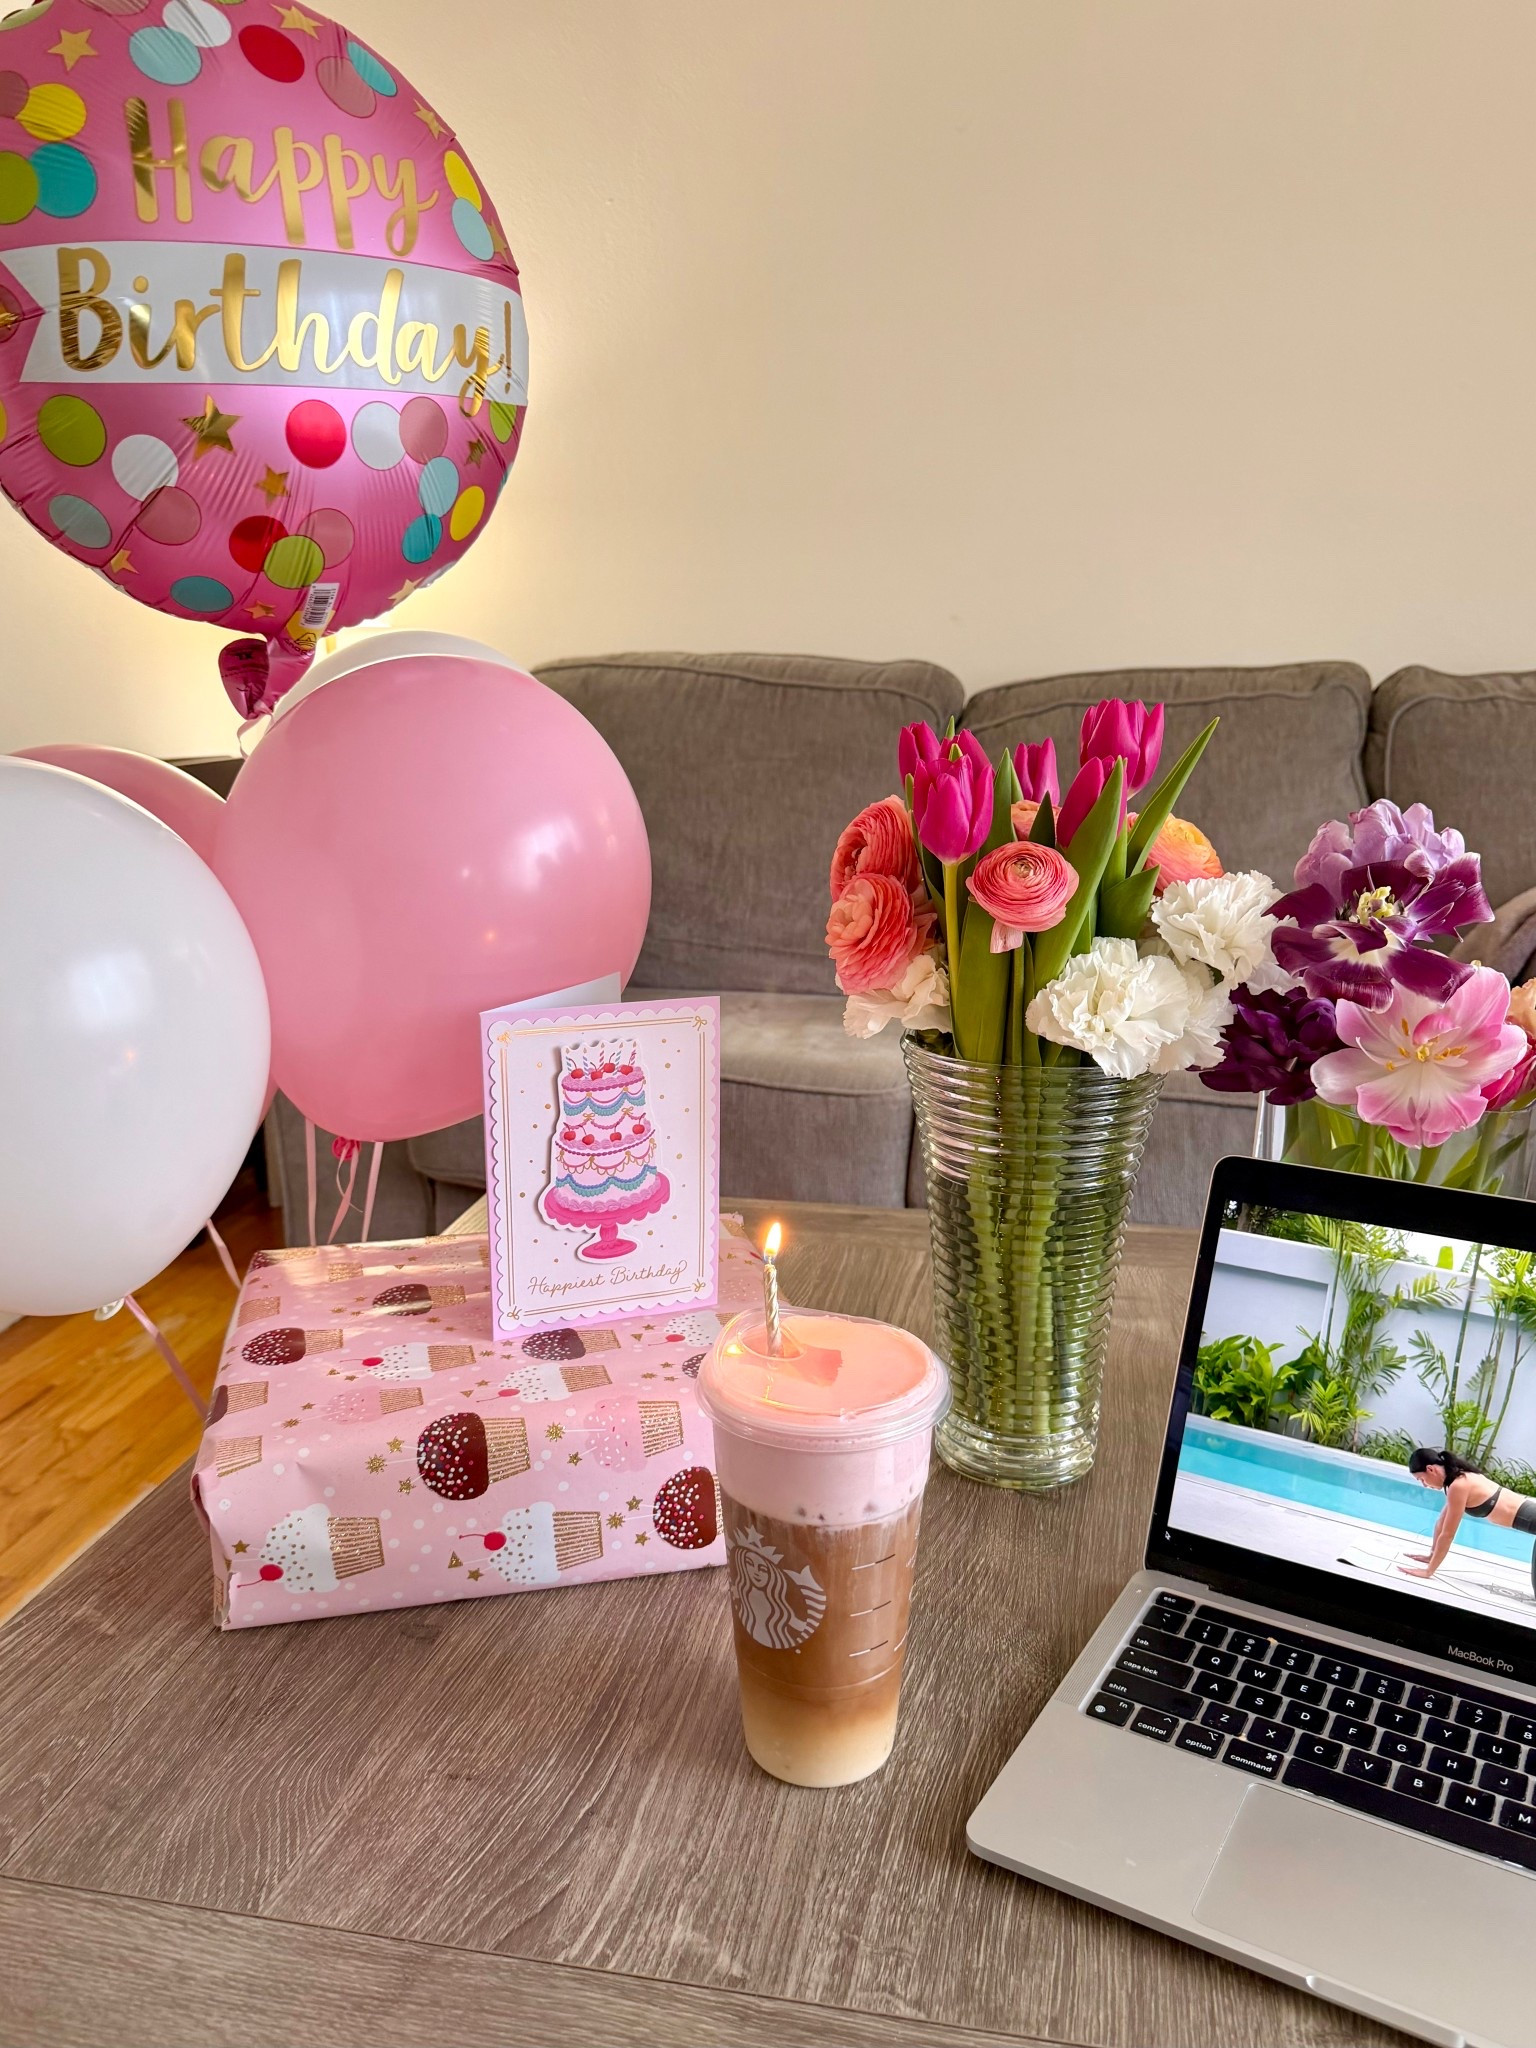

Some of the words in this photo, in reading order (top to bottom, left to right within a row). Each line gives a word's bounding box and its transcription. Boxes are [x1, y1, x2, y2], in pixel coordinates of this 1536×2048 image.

[124, 96, 438, 257] Happy
[56, 246, 514, 418] Birthday!
[527, 1274, 606, 1298] Happiest
[610, 1259, 688, 1285] Birthday
[1163, 1596, 1177, 1604] esc
[1136, 1637, 1149, 1646] tab
[1242, 1644, 1252, 1653] 2
[1210, 1656, 1221, 1666] Q
[1286, 1658, 1295, 1666] 3
[1447, 1645, 1495, 1668] MacBook
[1496, 1659, 1514, 1673] Pro
[1123, 1660, 1142, 1671] caps
[1142, 1665, 1159, 1676] lock
[1254, 1669, 1267, 1679] W
[1108, 1682, 1128, 1693] shift
[1209, 1683, 1219, 1691] A
[1299, 1684, 1309, 1693] E
[1377, 1686, 1386, 1694] 5
[1118, 1701, 1129, 1709] fn
[1254, 1697, 1265, 1706] S
[1345, 1699, 1355, 1708] R
[1424, 1701, 1433, 1709] 6
[1219, 1713, 1230, 1723] Z
[1300, 1711, 1311, 1721] D
[1394, 1713, 1403, 1722] T
[1474, 1715, 1483, 1723] 7
[1137, 1721, 1167, 1735] control
[1348, 1727, 1358, 1735] F
[1265, 1729, 1277, 1739] X
[1443, 1729, 1453, 1738] Y
[1523, 1731, 1533, 1740] 8
[1185, 1738, 1213, 1752] option
[1313, 1745, 1324, 1754] C
[1396, 1743, 1407, 1753] G
[1492, 1745, 1503, 1755] U
[1230, 1754, 1273, 1773] command
[1363, 1761, 1374, 1770] V
[1446, 1759, 1458, 1769] H
[1413, 1778, 1424, 1788] B
[1499, 1777, 1509, 1786] J
[1465, 1795, 1477, 1806] N
[1518, 1813, 1532, 1824] M
